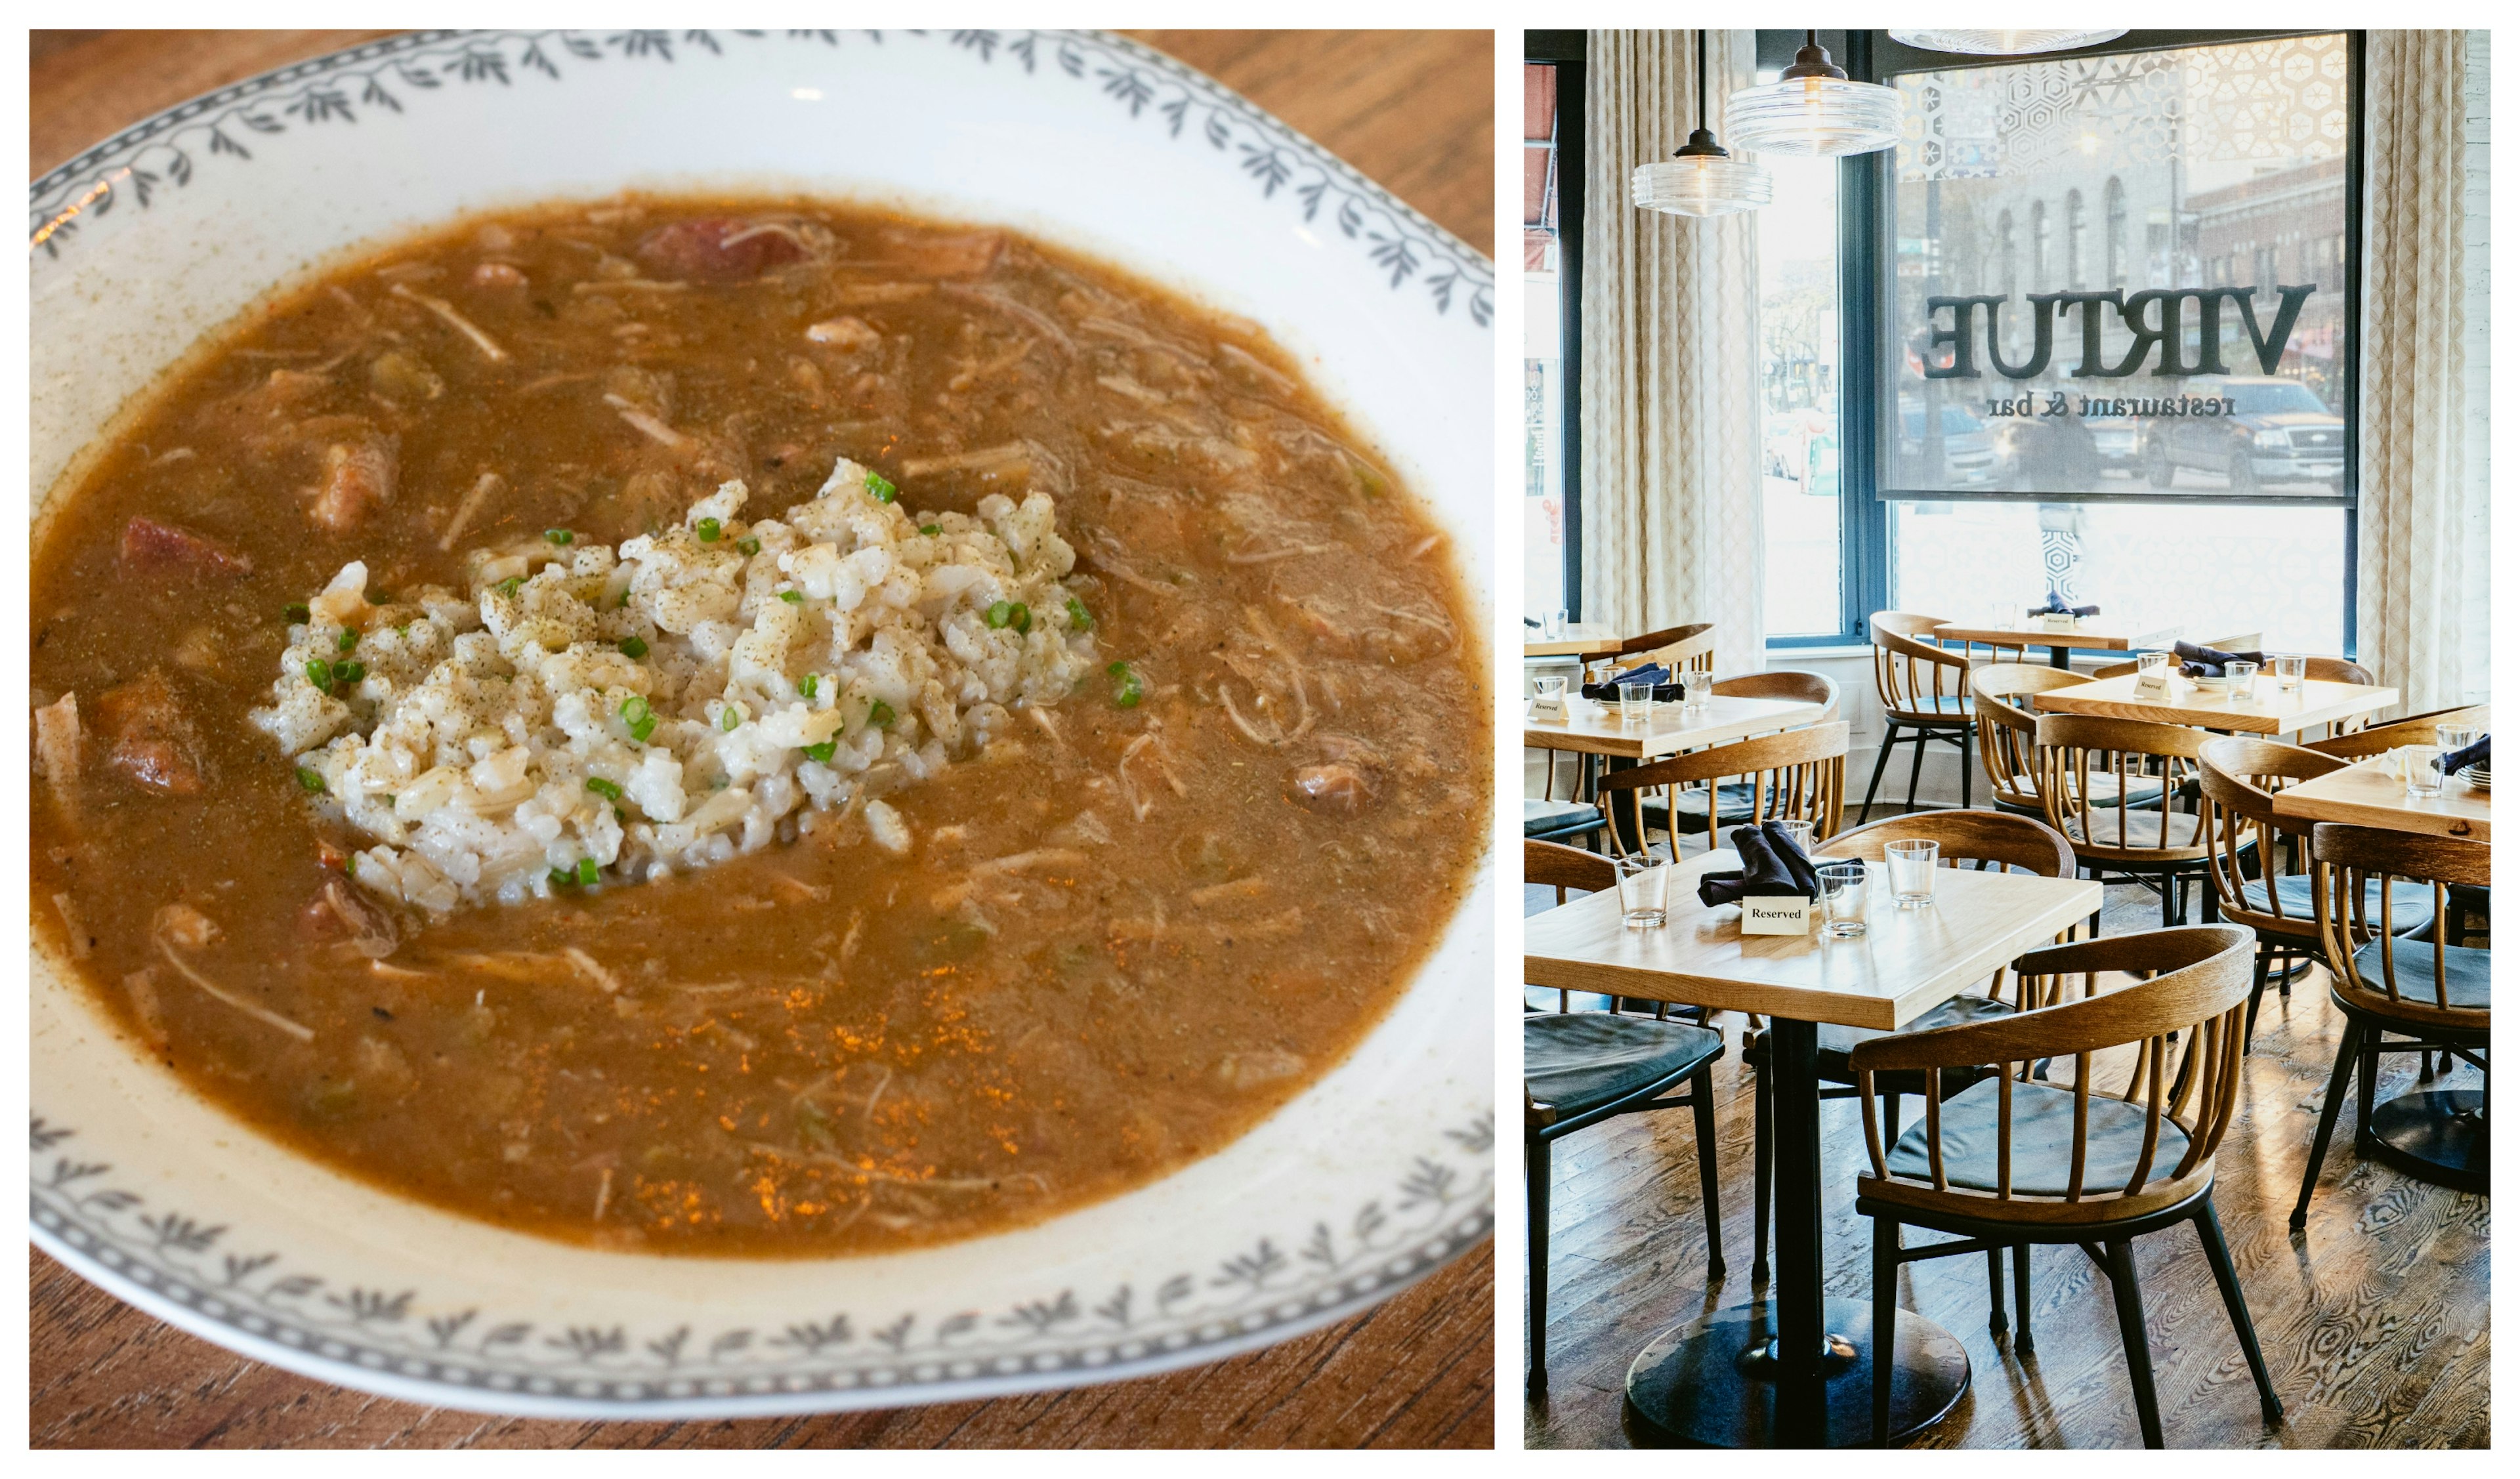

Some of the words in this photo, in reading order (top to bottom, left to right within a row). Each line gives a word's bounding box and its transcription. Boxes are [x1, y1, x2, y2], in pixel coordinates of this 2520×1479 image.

[2141, 681, 2162, 690] Reserved
[1536, 703, 1558, 711] Reserved
[1752, 908, 1801, 919] Reserved
